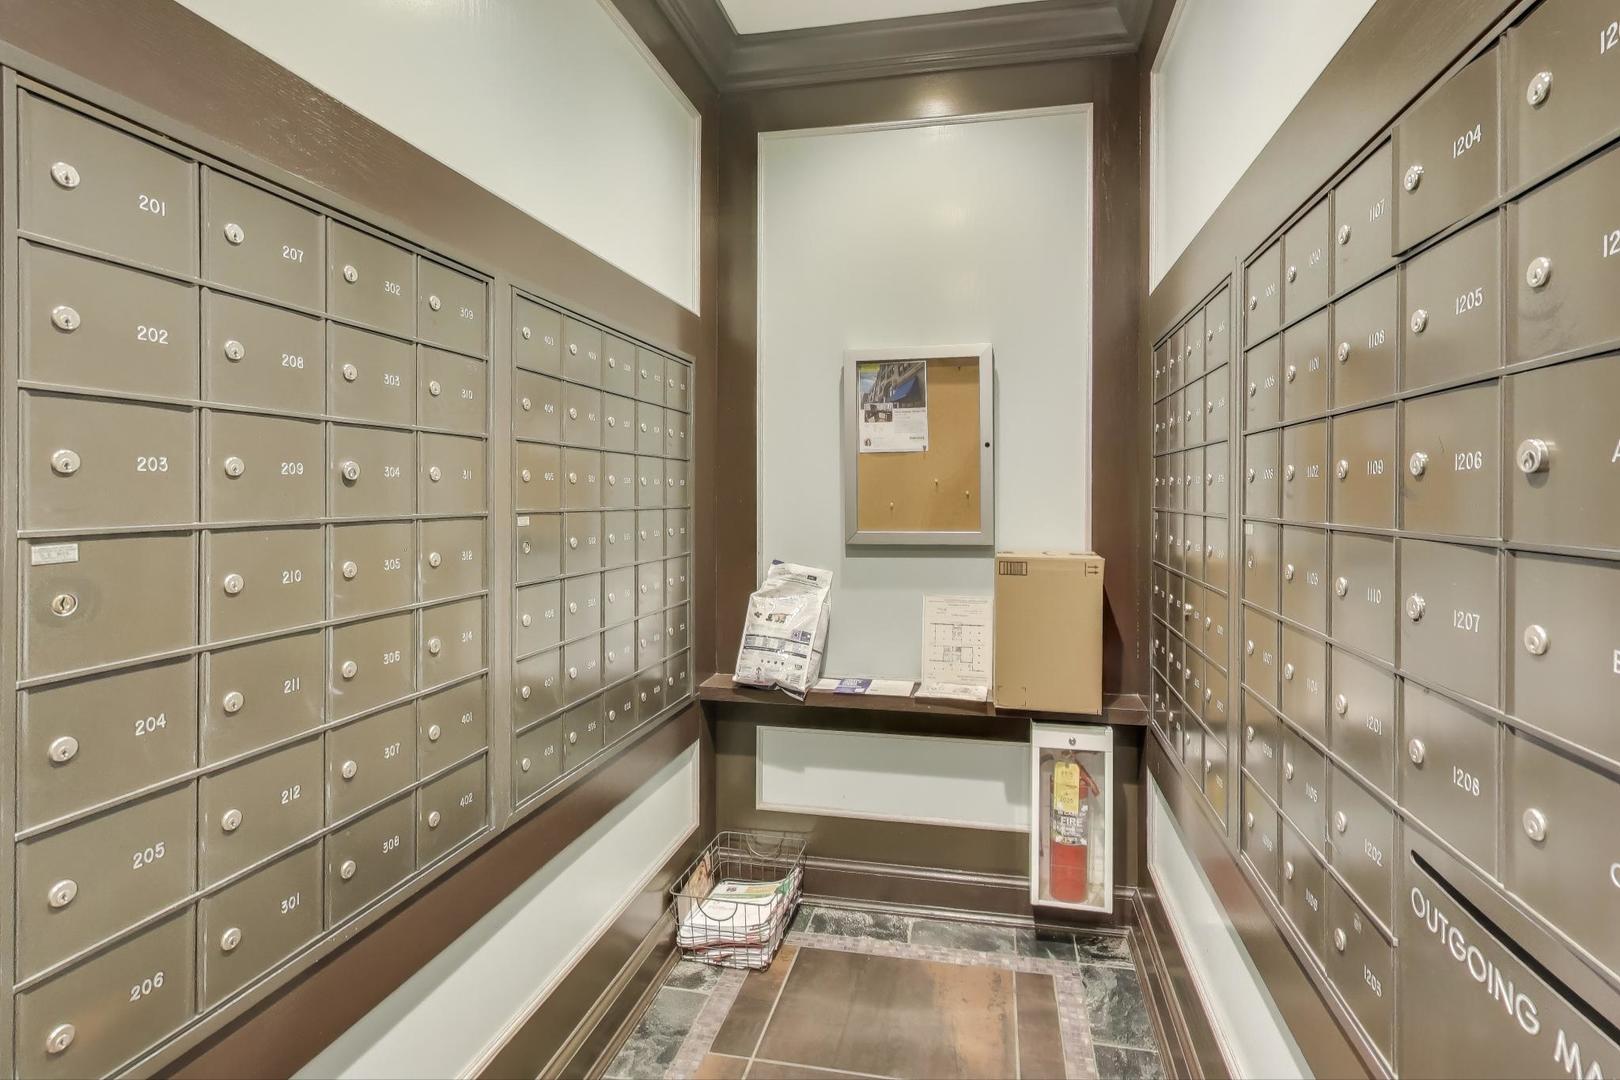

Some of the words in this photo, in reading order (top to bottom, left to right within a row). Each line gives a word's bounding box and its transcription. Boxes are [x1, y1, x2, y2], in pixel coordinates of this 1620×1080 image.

[1453, 123, 1482, 159] 1204
[138, 194, 166, 217] 201
[1369, 198, 1385, 223] 1107
[282, 245, 304, 264] 207
[384, 280, 401, 296] 302
[1455, 287, 1483, 315] 1205
[137, 325, 169, 345] 202
[1368, 329, 1385, 348] 1108
[281, 353, 304, 369] 208
[383, 373, 400, 387] 303
[136, 456, 169, 472] 203
[281, 462, 304, 475] 209
[1367, 459, 1384, 475] 1109
[1454, 450, 1482, 471] 1206
[384, 466, 401, 478] 304
[383, 558, 401, 571] 305
[282, 569, 302, 585] 210
[1367, 587, 1382, 604] 1110
[1453, 609, 1481, 633] 1207
[383, 650, 401, 665] 306
[283, 677, 300, 694] 211
[135, 712, 167, 736] 204
[461, 711, 473, 725] 401
[1366, 711, 1382, 735] 1201
[384, 742, 401, 759] 307
[1453, 765, 1480, 797] 1208
[281, 784, 301, 805] 212
[459, 792, 473, 808] 402
[1060, 816, 1083, 828] FIRE
[382, 835, 400, 854] 308
[1364, 838, 1382, 867] 1202
[132, 841, 165, 870] 205
[281, 892, 300, 914] 301
[1410, 887, 1541, 1036] OUTGOING
[129, 971, 164, 1002] 206
[1363, 965, 1382, 998] 1203
